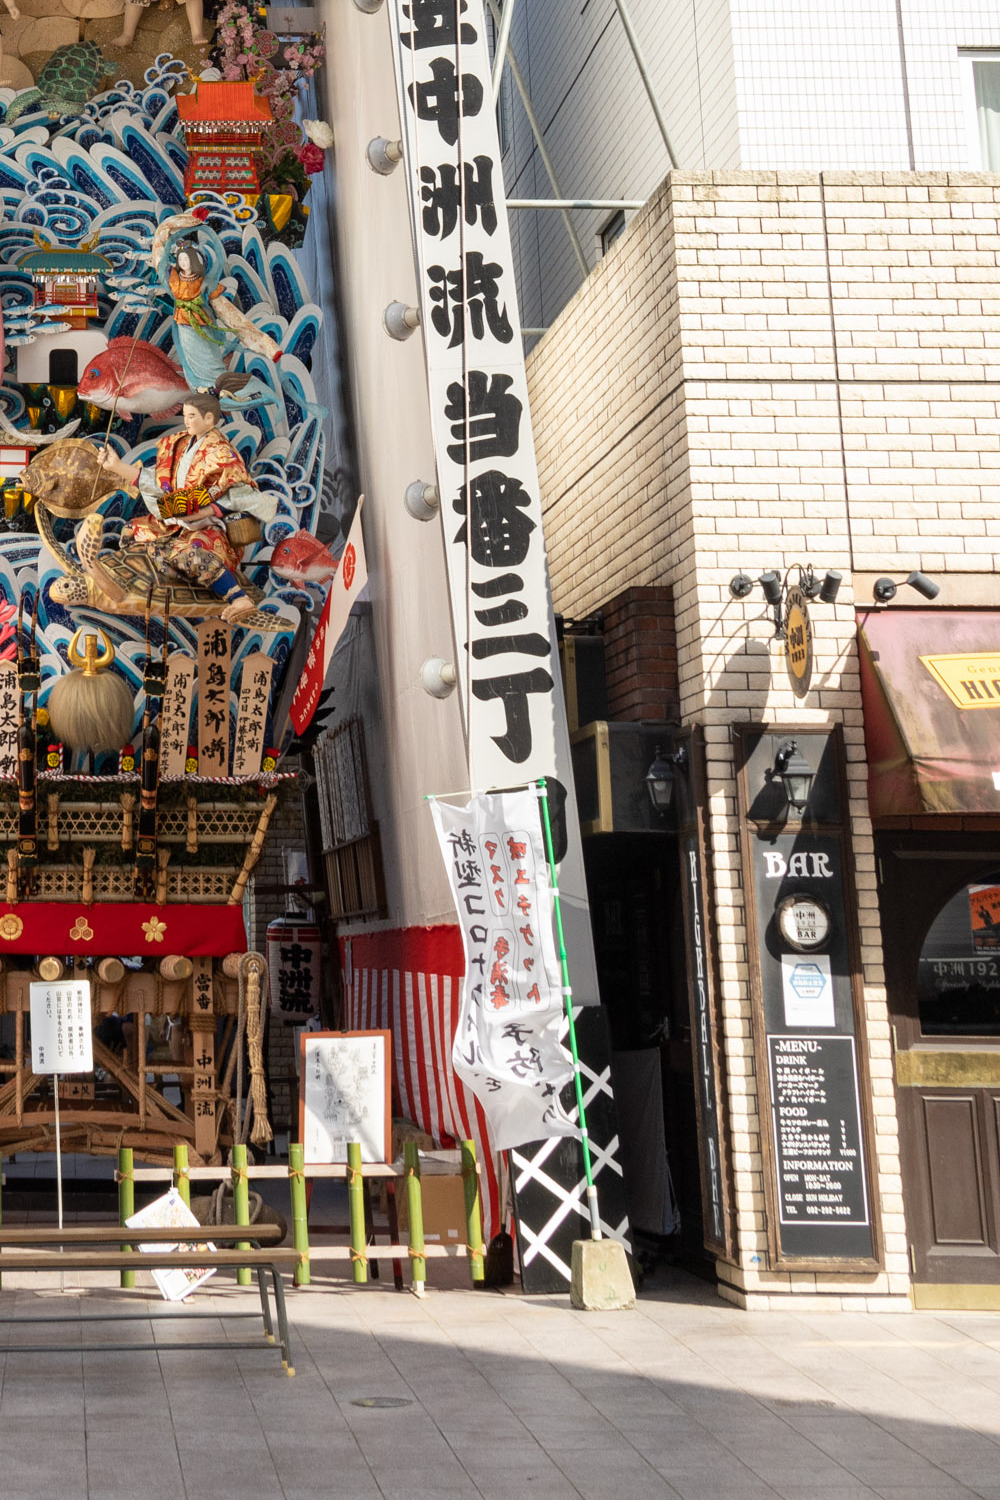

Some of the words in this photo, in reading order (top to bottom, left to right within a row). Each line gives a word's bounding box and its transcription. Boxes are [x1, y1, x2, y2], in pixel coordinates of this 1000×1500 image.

[763, 851, 834, 878] BAR
[278, 943, 314, 1013] 中洲流
[775, 1055, 807, 1065] DRINK
[196, 1053, 214, 1117] 中洲流
[779, 1107, 808, 1117] FOOD
[783, 1160, 853, 1171] INFORMATION
[785, 1193, 804, 1202] CLOSE
[785, 1206, 798, 1214] TEL
